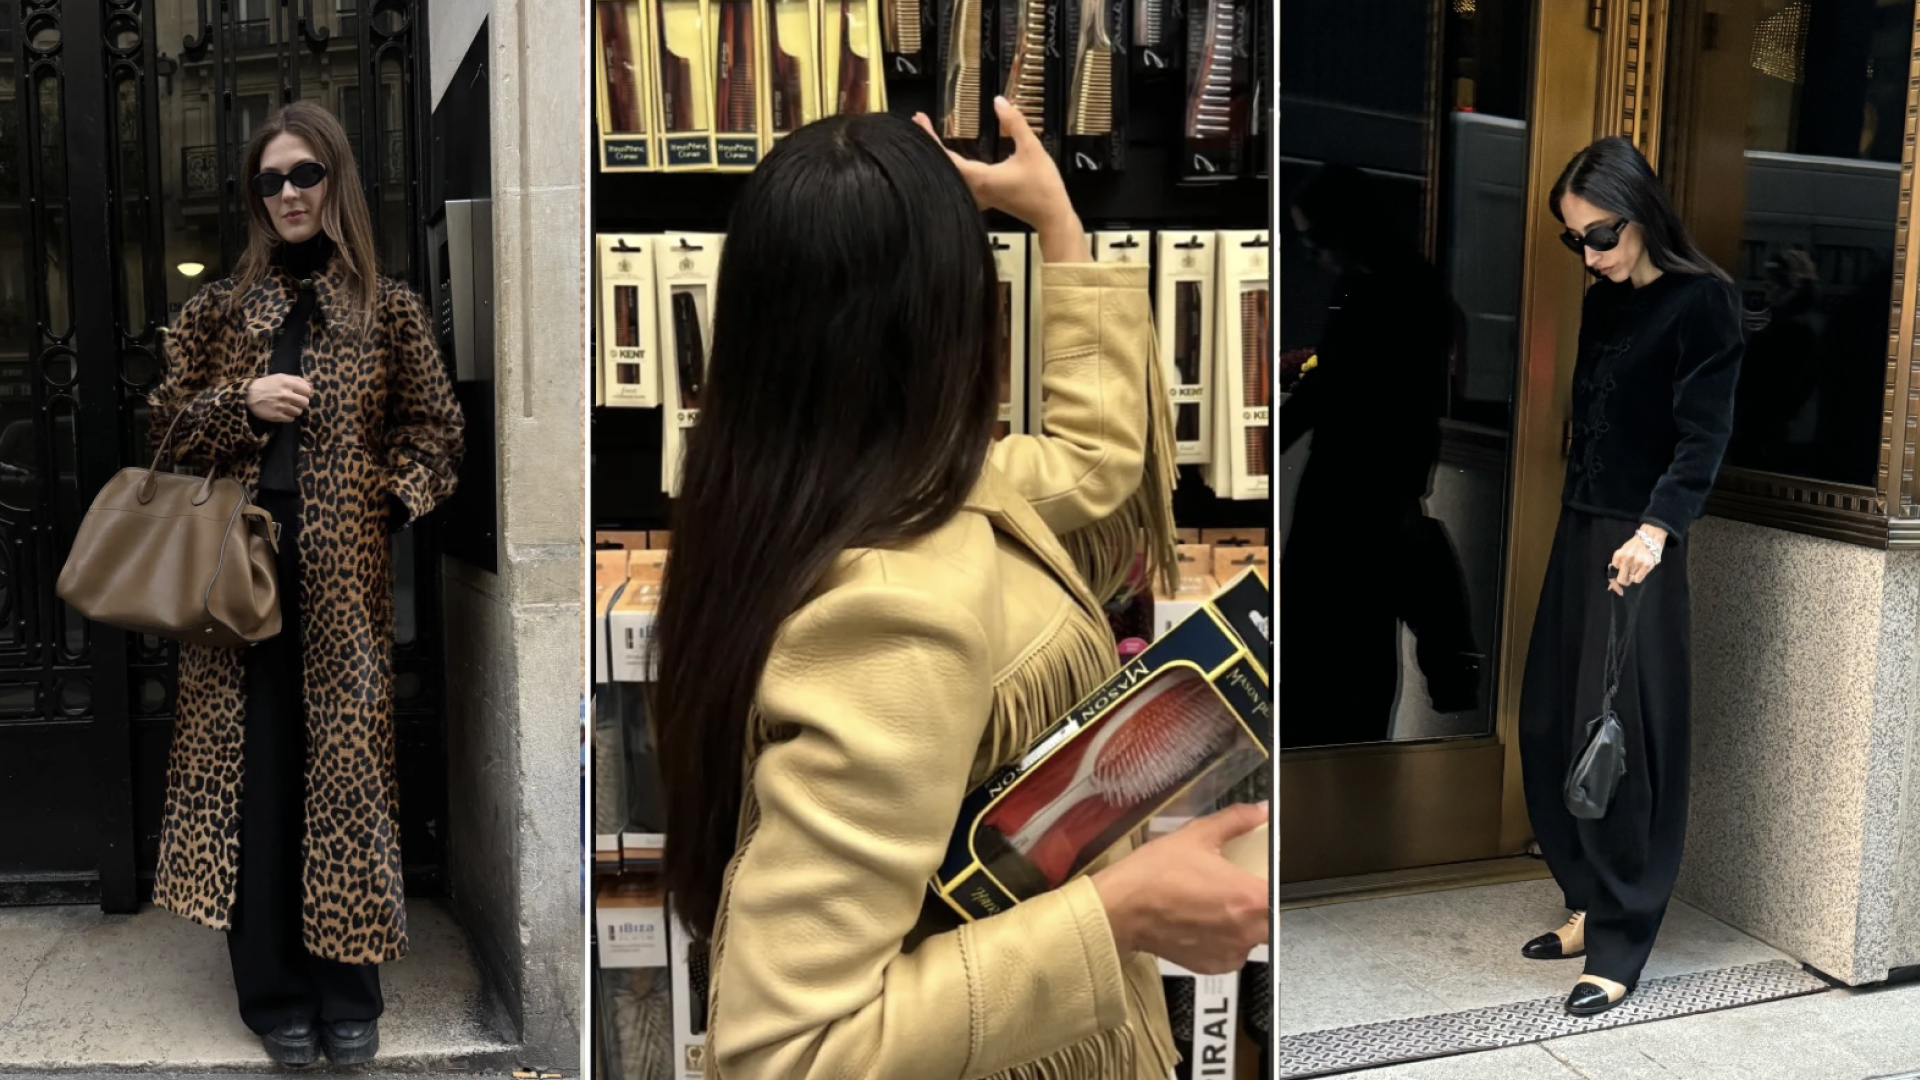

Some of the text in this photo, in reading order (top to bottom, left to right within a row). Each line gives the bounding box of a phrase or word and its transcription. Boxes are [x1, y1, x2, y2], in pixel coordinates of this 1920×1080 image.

[619, 349, 646, 359] KENT
[1179, 387, 1204, 396] KENT
[1201, 996, 1228, 1080] IRAL
